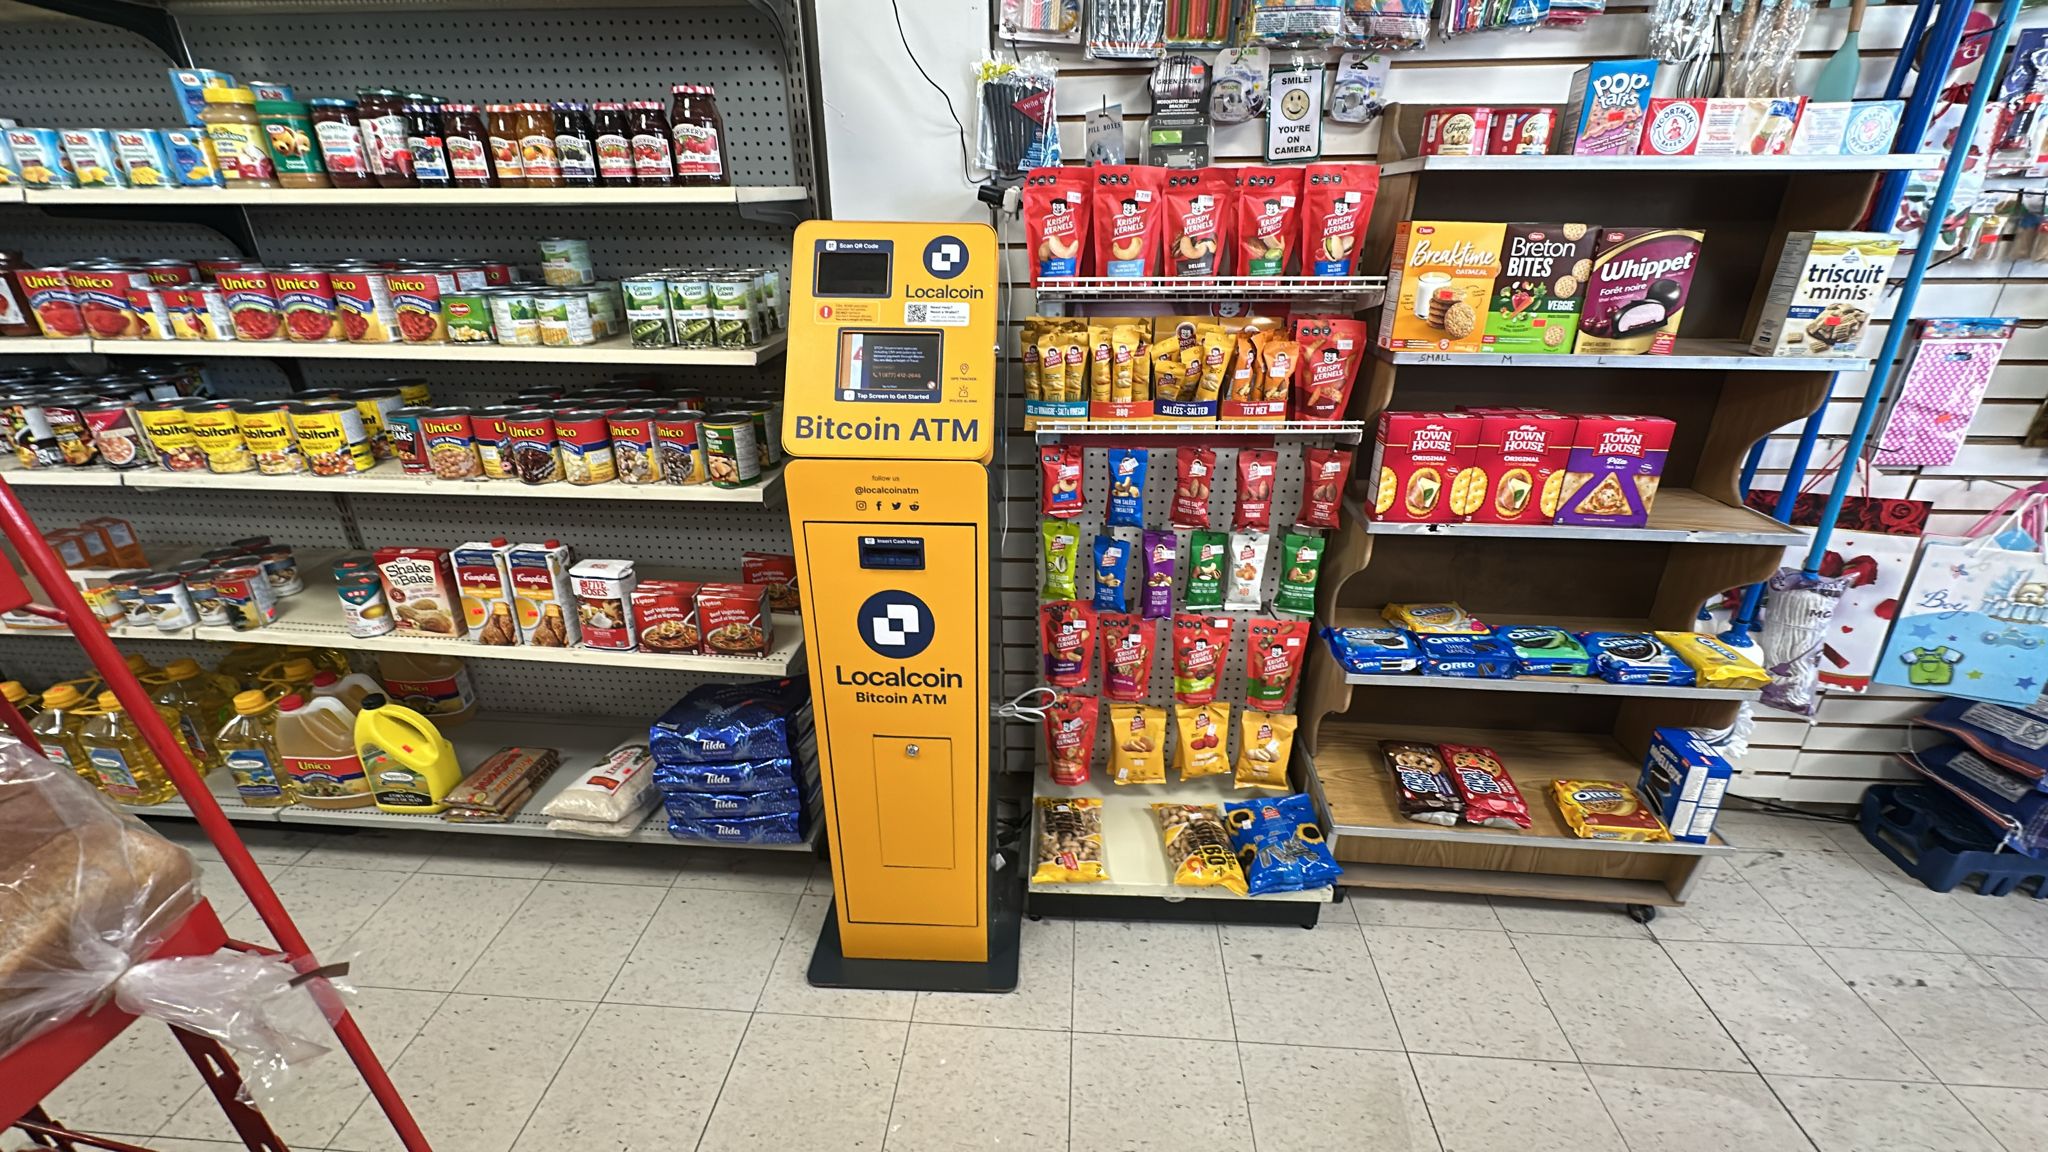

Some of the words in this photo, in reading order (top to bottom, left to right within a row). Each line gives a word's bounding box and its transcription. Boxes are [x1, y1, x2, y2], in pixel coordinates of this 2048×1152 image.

[1281, 75, 1312, 86] SMILE!
[1598, 90, 1640, 109] tarts
[1710, 103, 1746, 111] Strawberry
[1656, 106, 1694, 129] VOORTMAN
[1088, 125, 1101, 134] PILL
[1102, 122, 1121, 132] BOXES
[1278, 124, 1311, 134] YOU'RE
[1446, 120, 1472, 133] Trophy
[1287, 135, 1300, 144] ON
[1660, 136, 1687, 147] BAKERY
[1274, 145, 1312, 155] CAMERA
[1046, 215, 1070, 227] KRISPY
[1116, 216, 1141, 227] KRISPY
[1186, 214, 1210, 226] KRISPY
[1260, 215, 1283, 227] KRISPY
[1327, 215, 1352, 226] KRISPY
[1044, 221, 1074, 236] KERNELS
[1114, 222, 1144, 236] KERNELS
[1184, 220, 1214, 235] KERNELS
[1257, 222, 1282, 235] KERNELS
[1323, 221, 1354, 236] KERNELS
[1409, 239, 1496, 267] Breaktime
[1510, 237, 1577, 258] Breton
[1188, 262, 1206, 270] DELUXE
[1455, 268, 1488, 276] OATMEAL
[1506, 258, 1554, 278] BITES
[1600, 252, 1696, 282] Whippet
[1808, 263, 1885, 284] triscuit
[72, 276, 114, 289] Unico
[221, 277, 267, 291] Unico
[275, 277, 319, 291] Unico
[387, 279, 425, 292] Unico
[633, 284, 653, 292] Green
[682, 284, 702, 292] Green
[905, 284, 984, 299] Localcoin
[1599, 286, 1622, 296] Forêt
[1624, 282, 1647, 292] noire
[1809, 284, 1869, 300] minis
[1547, 300, 1576, 311] VEGGIE
[1418, 353, 1451, 363] SMALL
[1501, 355, 1513, 364] M
[1316, 363, 1342, 373] KRISPY
[1313, 370, 1344, 382] KERNELS
[1115, 408, 1129, 417] BBQ
[1162, 404, 1183, 415] SALÉES
[1186, 406, 1209, 415] SALTED
[1243, 406, 1255, 415] TEX
[1255, 406, 1268, 415] MEX
[424, 422, 463, 434] Unico
[508, 426, 545, 438] Unico
[795, 415, 900, 441] Bitcoin
[909, 418, 978, 443] ATM
[1414, 430, 1451, 442] TOWN
[1507, 430, 1547, 442] TOWN
[1602, 433, 1642, 445] TOWN
[1411, 440, 1452, 452] HOUSE
[1504, 440, 1544, 453] HOUSE
[1599, 442, 1641, 456] HOUSE
[1412, 455, 1447, 463] ORIGINAL
[1503, 455, 1540, 463] ORIGINAL
[1606, 456, 1628, 466] Pita
[854, 486, 919, 496] @localcoinatm
[385, 562, 431, 577] Shake
[399, 574, 433, 586] Bake
[463, 571, 499, 583] Campbell's
[516, 572, 550, 584] Campbell's
[588, 580, 606, 590] FIVE
[581, 587, 608, 597] ROSES
[1916, 588, 1969, 620] Boy
[1410, 606, 1453, 617] OREO
[1058, 634, 1079, 643] KRISPY
[1427, 636, 1471, 644] OREO
[1508, 630, 1555, 639] OREO
[1598, 638, 1647, 648] OREO
[1696, 637, 1738, 660] OREO
[1115, 654, 1139, 664] KERNELS
[1117, 649, 1137, 658] KRISPY
[1190, 650, 1211, 660] KRISPY
[1188, 655, 1213, 666] KERNELS
[1264, 661, 1288, 672] KERNELS
[1266, 657, 1286, 667] KRISPY
[1355, 661, 1380, 670] OREO
[1438, 661, 1476, 671] OREO
[1524, 663, 1551, 671] OREO
[835, 665, 963, 688] Localcoin
[1621, 673, 1648, 681] OREO
[855, 692, 908, 704] Bitcoin
[911, 694, 947, 705] ATM
[700, 739, 726, 750] Tilda
[298, 761, 332, 771] Unico
[704, 772, 730, 784] Tilda
[1572, 789, 1623, 801] OREO
[711, 798, 738, 809] Tilda
[714, 824, 741, 836] Tilda
